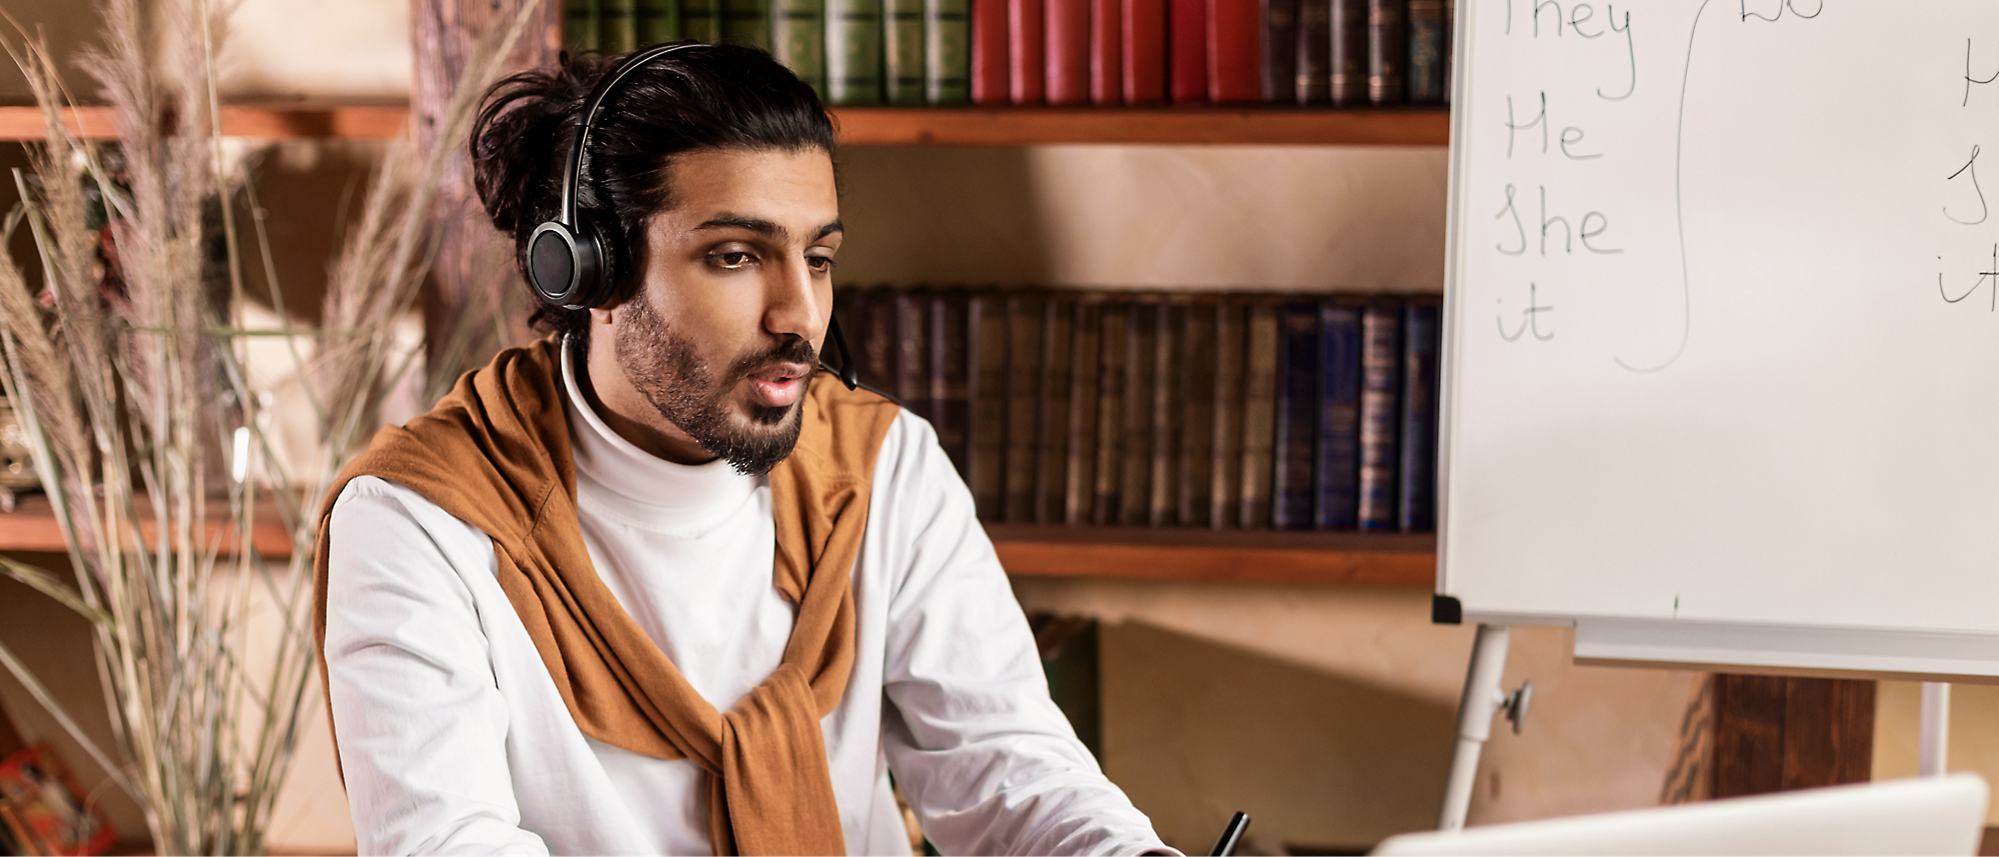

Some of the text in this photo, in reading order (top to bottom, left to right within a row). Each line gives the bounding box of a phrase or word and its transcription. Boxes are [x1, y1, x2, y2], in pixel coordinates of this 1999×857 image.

[1505, 91, 1603, 159] He
[1495, 183, 1624, 256] She
[1497, 281, 1555, 342] it
